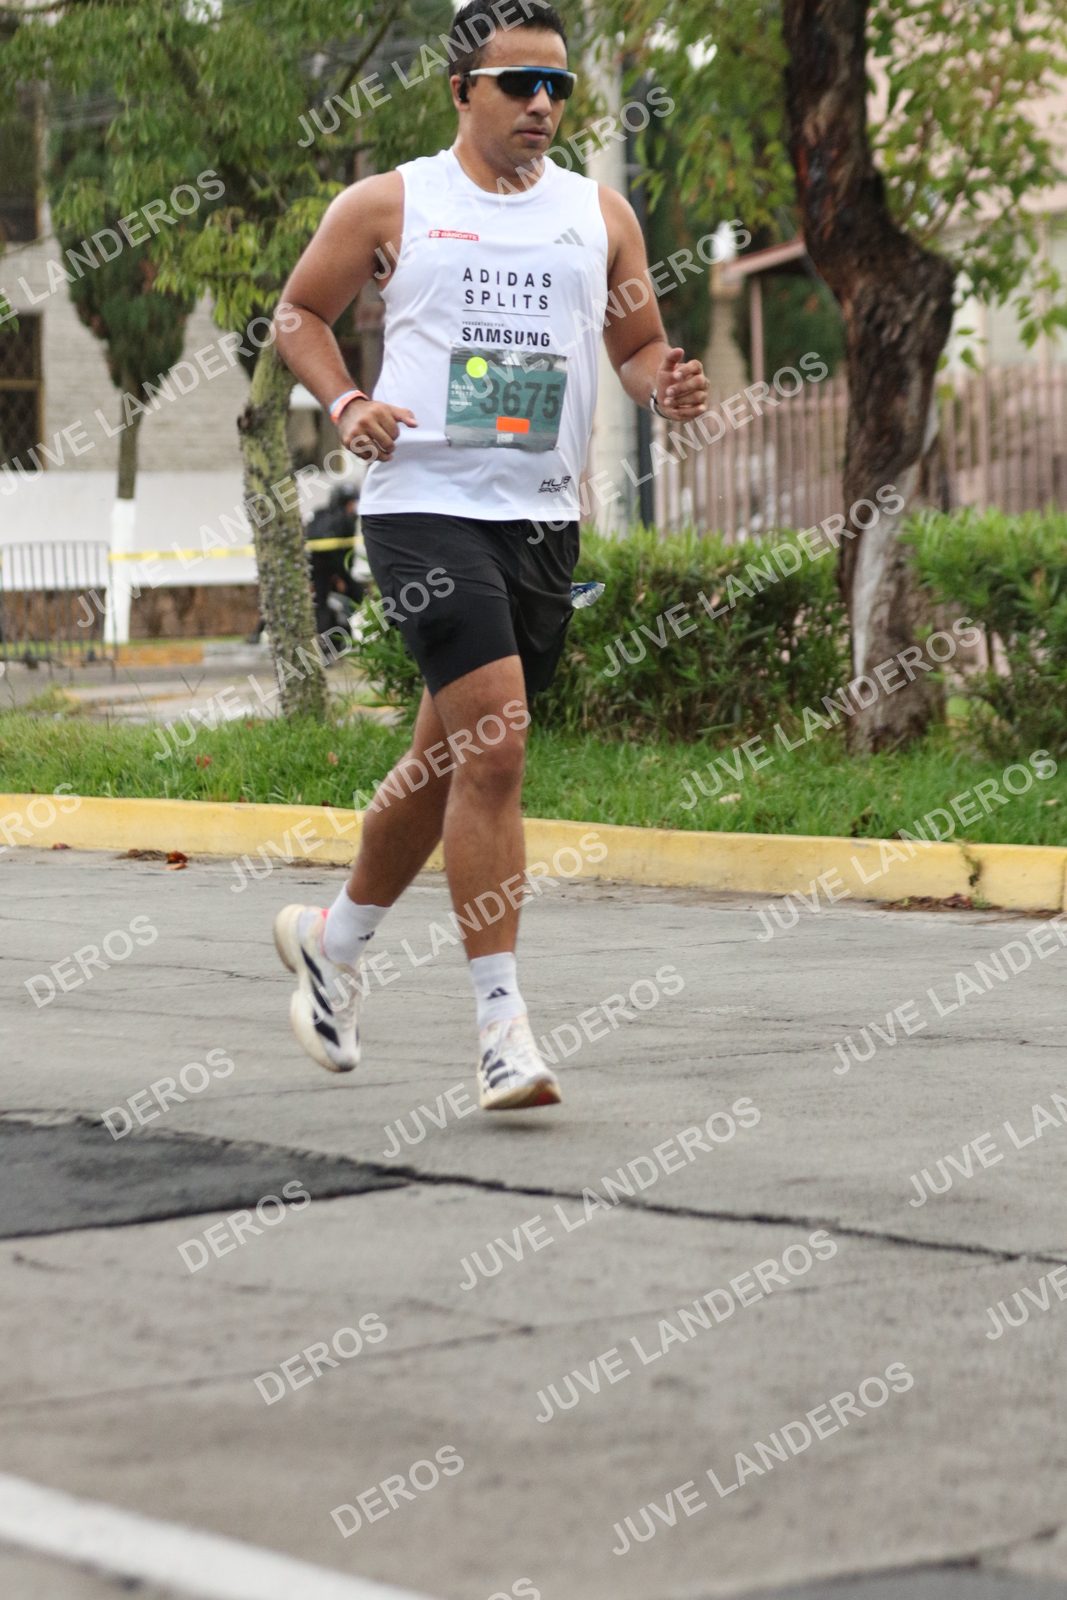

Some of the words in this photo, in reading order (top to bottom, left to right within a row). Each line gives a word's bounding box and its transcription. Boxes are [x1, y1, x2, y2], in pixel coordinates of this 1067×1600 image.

[462, 267, 552, 288] ADIDAS
[465, 289, 549, 310] SPLITS
[462, 326, 550, 347] SAMSUNG
[479, 378, 561, 420] 3675
[540, 475, 572, 488] HUB
